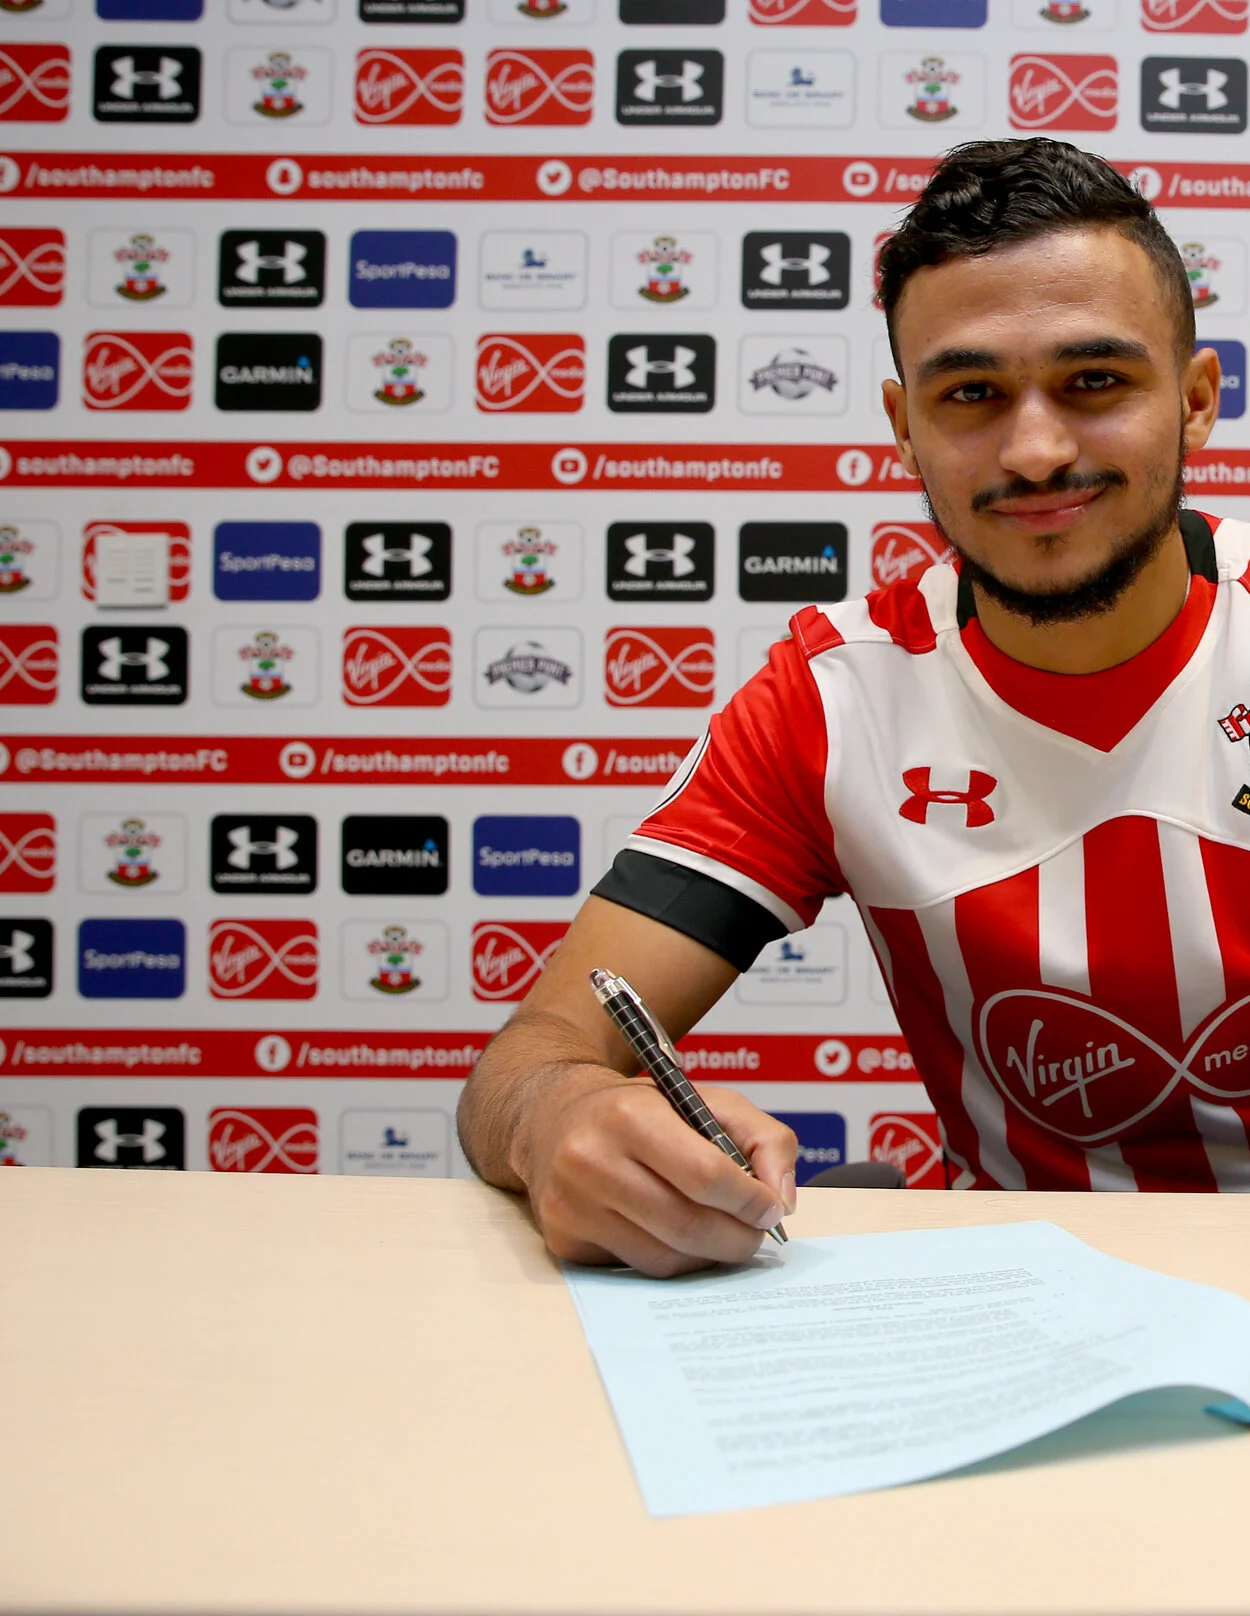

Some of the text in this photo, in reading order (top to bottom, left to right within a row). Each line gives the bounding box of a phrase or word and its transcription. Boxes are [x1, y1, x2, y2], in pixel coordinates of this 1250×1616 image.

[309, 168, 484, 192] southamptonfc
[578, 168, 789, 192] @SouthamptonFC
[356, 260, 450, 280] SportPesa
[220, 365, 313, 384] GARMIN
[288, 455, 499, 480] @SouthamptonFC
[593, 455, 782, 481] /southamptonfc
[220, 552, 315, 572] SportPesa
[744, 556, 838, 573] GARMIN
[321, 749, 509, 776] /southamptonfc
[346, 849, 439, 867] GARMIN
[480, 846, 574, 867] SportPesa
[84, 949, 180, 970] SportPesa
[1006, 1018, 1135, 1118] Virgin
